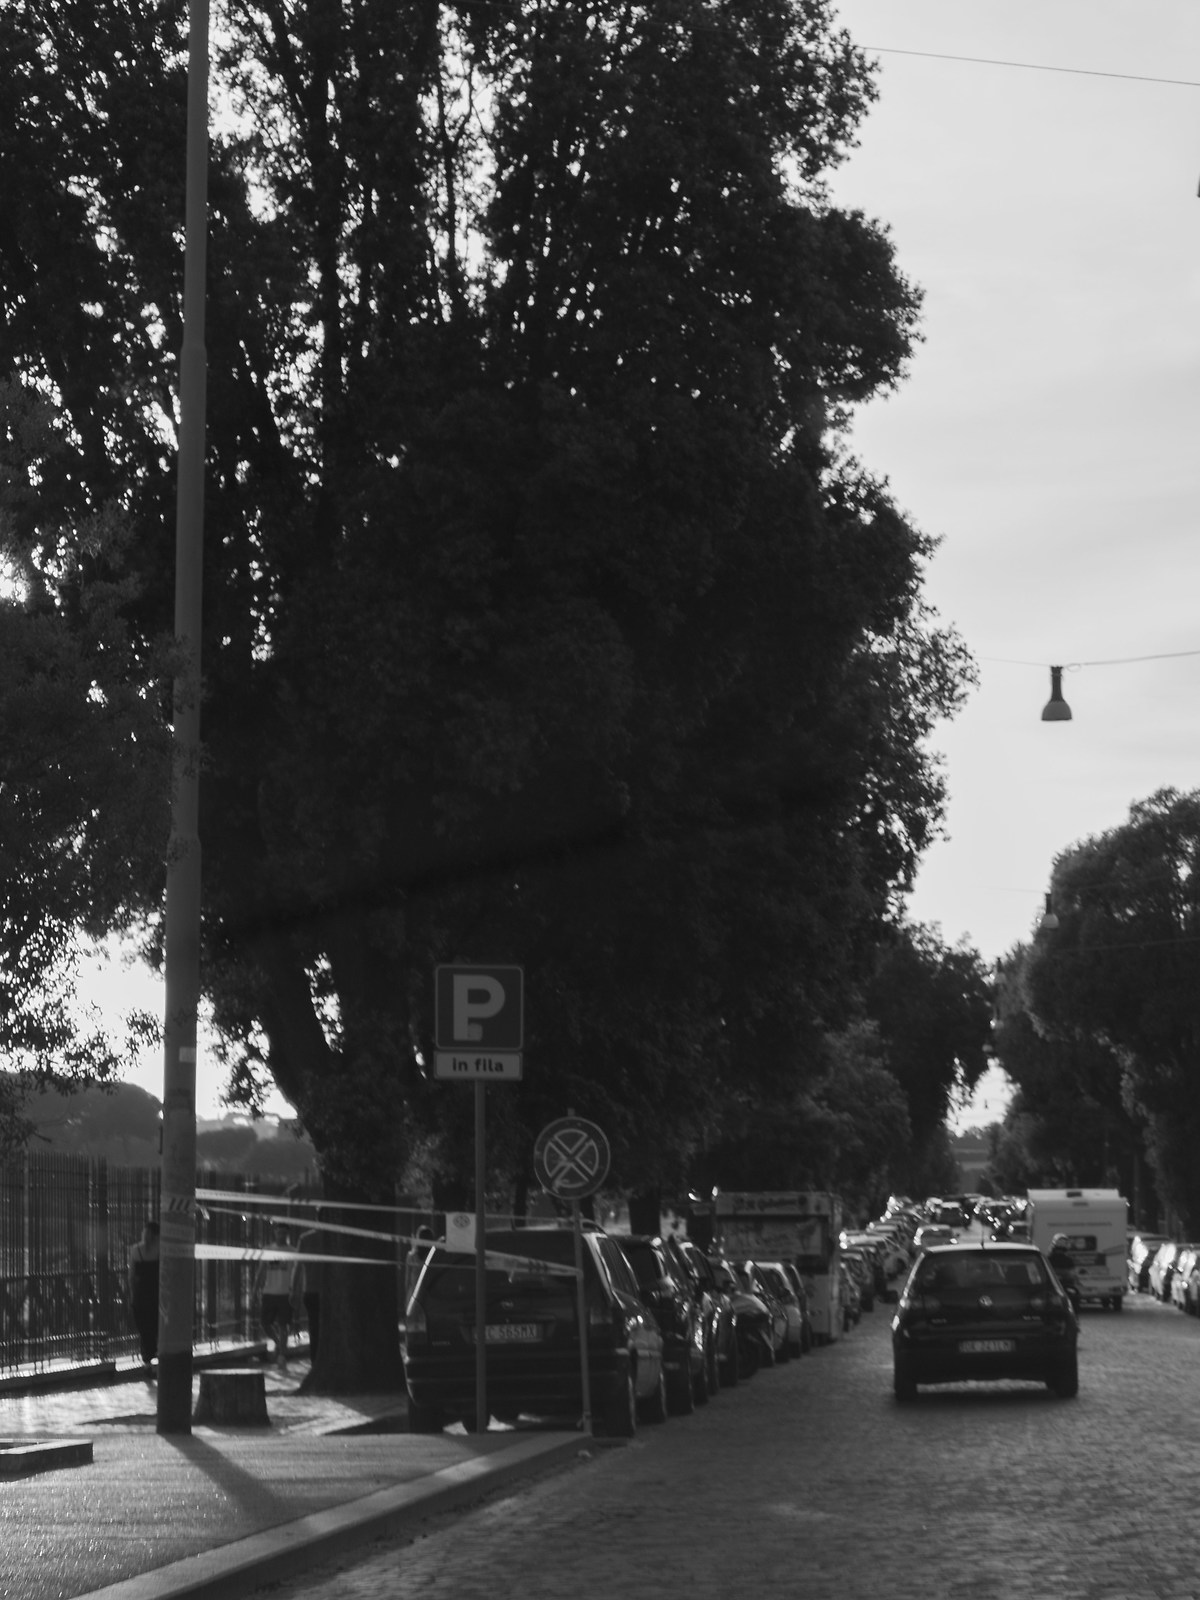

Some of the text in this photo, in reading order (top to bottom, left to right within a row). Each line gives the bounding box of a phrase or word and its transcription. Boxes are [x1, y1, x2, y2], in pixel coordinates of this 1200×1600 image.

[453, 974, 505, 1041] P
[452, 1057, 504, 1073] in fila
